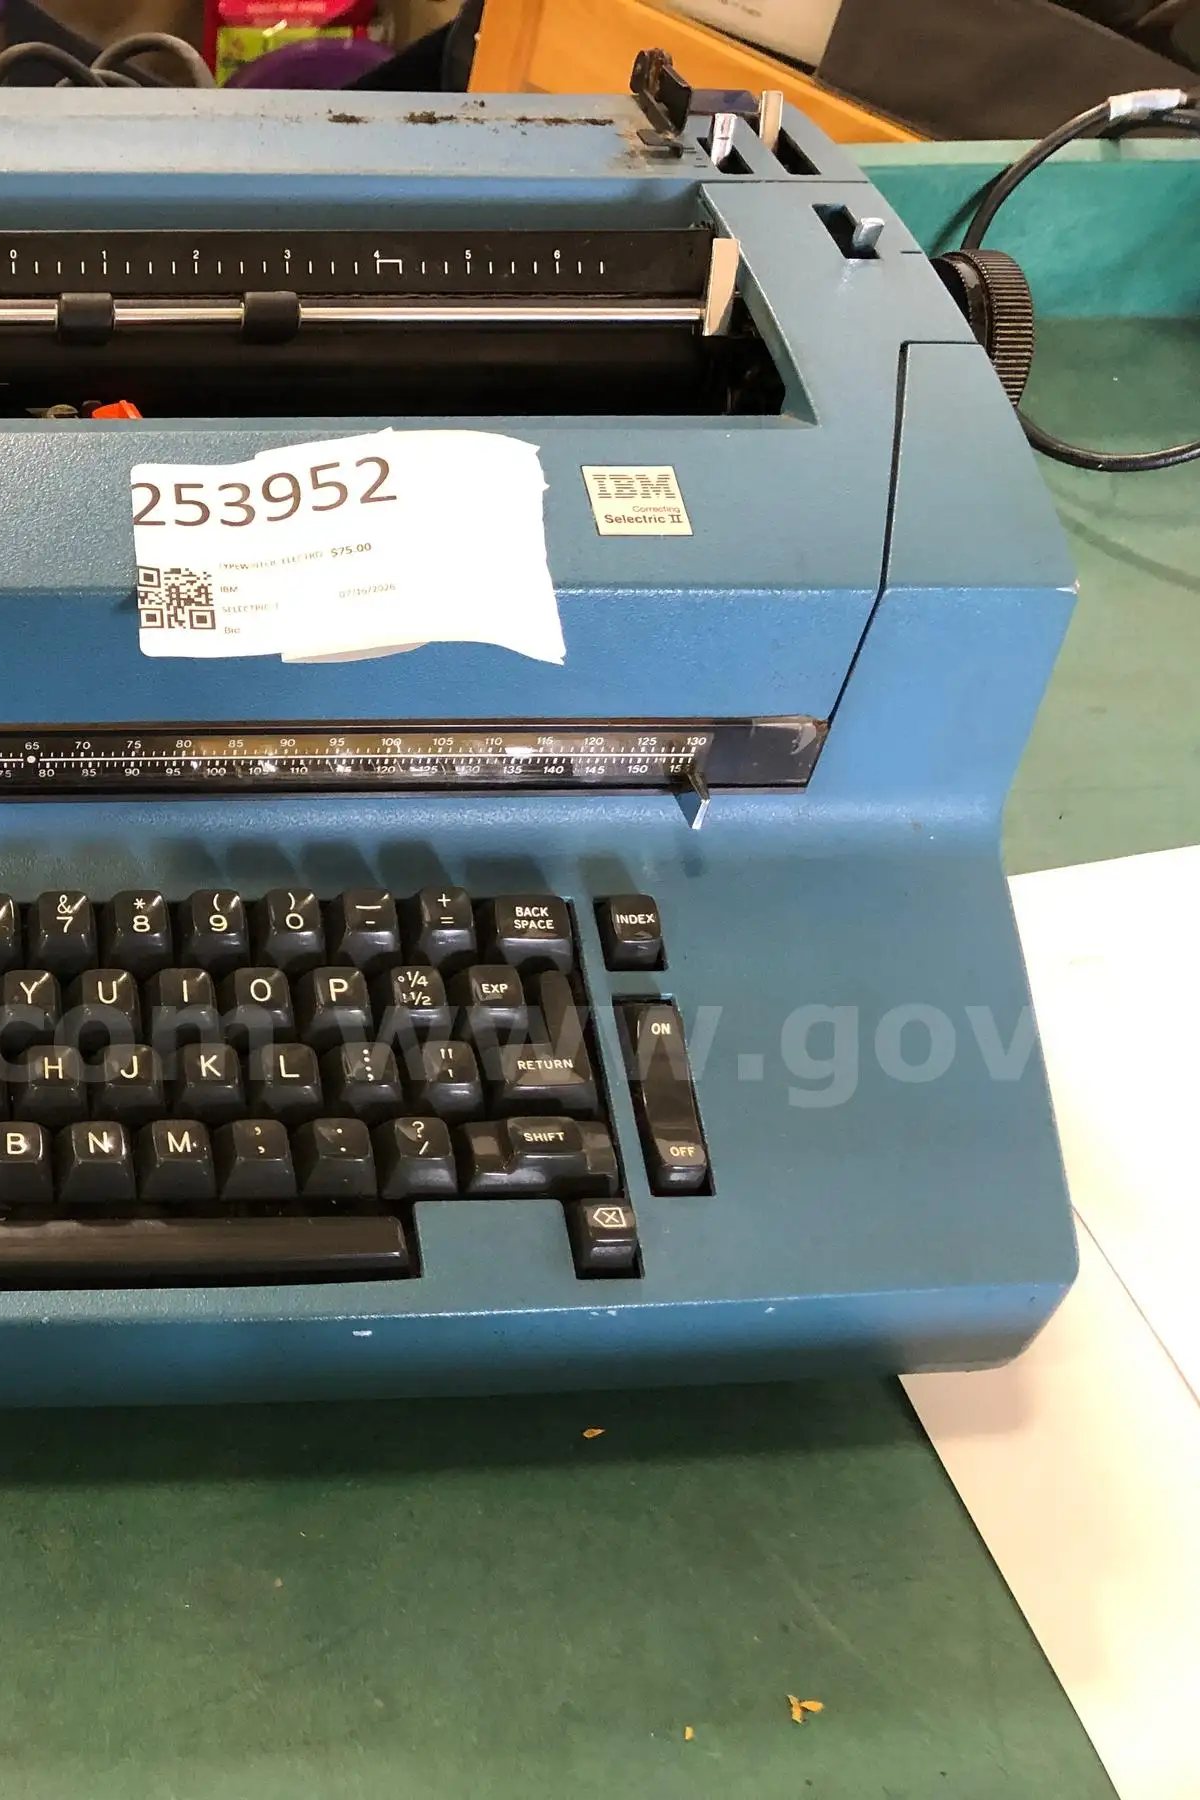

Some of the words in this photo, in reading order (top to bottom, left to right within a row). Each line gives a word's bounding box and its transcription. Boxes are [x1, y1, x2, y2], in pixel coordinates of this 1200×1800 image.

[10, 249, 17, 258] 0
[102, 249, 107, 259] 1
[193, 250, 199, 259] 2
[284, 250, 290, 259] 3
[374, 249, 380, 259] 4
[465, 250, 471, 259] 5
[554, 249, 560, 259] 6
[132, 456, 397, 526] 253952
[592, 474, 676, 499] IBM
[632, 505, 681, 514] Correcting
[604, 514, 666, 524] Selectric
[668, 514, 684, 524] II
[331, 543, 372, 558] $75.00
[25, 741, 40, 750] 65
[75, 741, 91, 750] 70
[126, 740, 142, 749] 75
[175, 739, 192, 748] 80
[228, 739, 244, 748] 85
[279, 738, 296, 747] 90
[329, 738, 345, 747] 95
[381, 737, 402, 747] 100
[433, 737, 453, 746] 105
[485, 737, 502, 746] 110
[536, 736, 553, 746] 115
[584, 736, 604, 746] 120
[637, 736, 657, 746] 125
[686, 736, 707, 746] 130
[38, 768, 55, 778] 80
[81, 768, 97, 777] 85
[124, 768, 140, 777] 90
[165, 767, 181, 777] 95
[206, 767, 227, 776] 100
[290, 766, 308, 776] 110
[375, 765, 396, 775] 120
[503, 765, 523, 775] 135
[543, 765, 564, 775] 140
[585, 765, 605, 774] 145
[627, 764, 648, 774] 150
[669, 765, 685, 774] 15
[515, 906, 549, 918] BACK
[56, 916, 74, 934] 7
[132, 915, 150, 933] 8
[209, 914, 228, 932] 9
[513, 919, 555, 930] SPACE
[616, 913, 656, 925] INDEX
[19, 981, 40, 1005] Y
[97, 980, 118, 1005] U
[182, 979, 189, 1003] I
[250, 978, 272, 1002] O
[328, 978, 349, 1002] P
[482, 983, 509, 994] EXP
[651, 1023, 671, 1035] ON
[44, 1056, 63, 1080] H
[120, 1056, 139, 1080] J
[200, 1054, 222, 1078] K
[279, 1054, 300, 1079] L
[517, 1058, 575, 1071] RETURN
[6, 1132, 28, 1155] B
[87, 1131, 110, 1154] N
[167, 1130, 192, 1153] M
[523, 1131, 565, 1143] SHIFT
[669, 1146, 695, 1158] OFF
